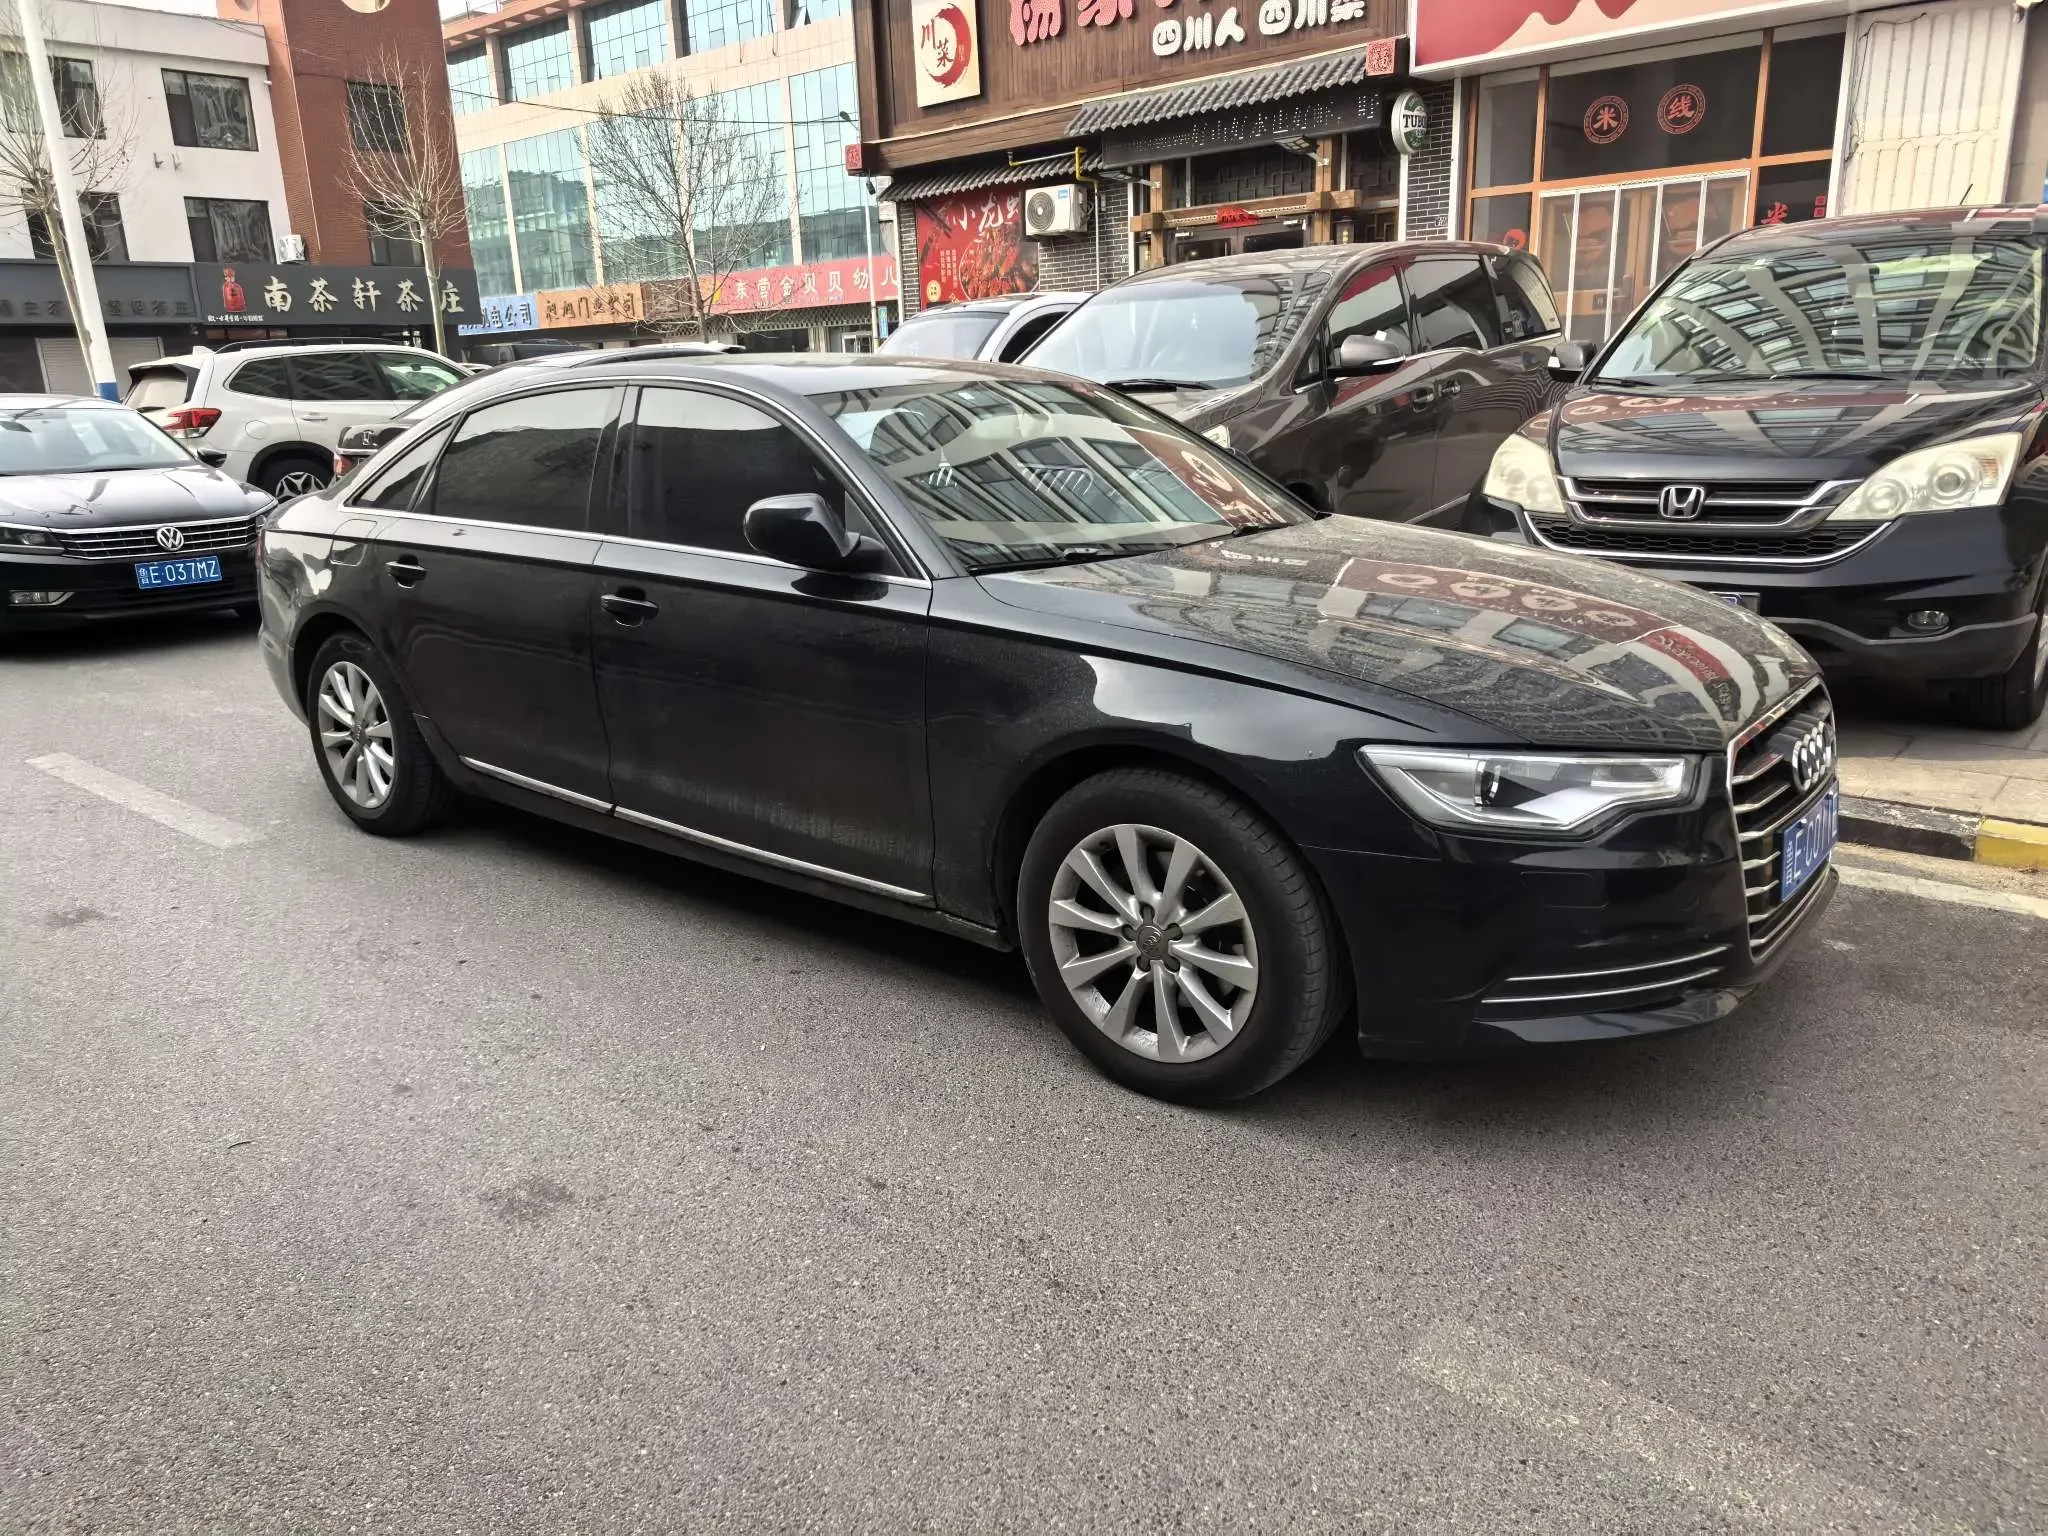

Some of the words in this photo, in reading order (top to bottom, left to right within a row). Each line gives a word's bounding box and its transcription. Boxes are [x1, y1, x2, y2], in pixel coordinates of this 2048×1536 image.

[920, 18, 954, 68] 川菜
[1152, 7, 1245, 56] 四川人
[264, 275, 465, 313] 南茶轩茶庄
